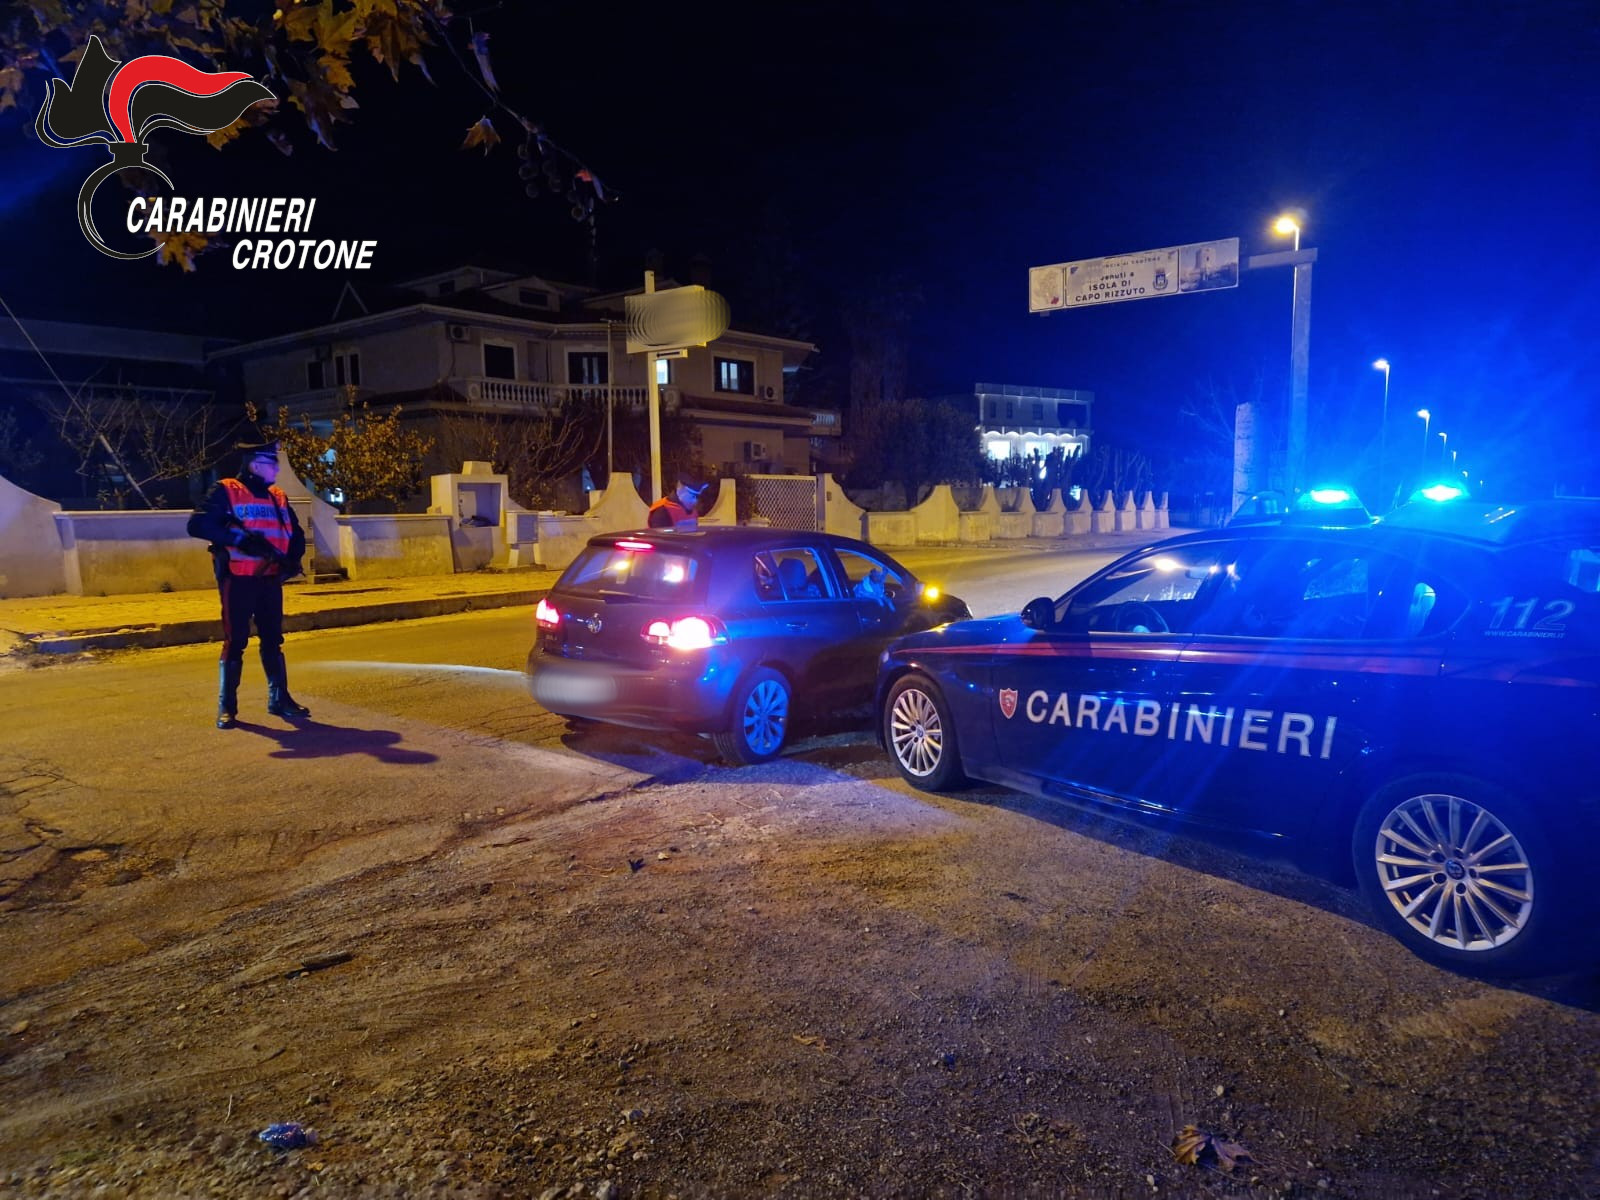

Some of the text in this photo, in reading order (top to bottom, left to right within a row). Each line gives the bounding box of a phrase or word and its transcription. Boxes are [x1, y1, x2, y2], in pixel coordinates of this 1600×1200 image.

[1075, 287, 1146, 302] CAPO RIZZUTO
[1089, 279, 1131, 291] ISOLA DI
[1489, 596, 1575, 631] 112
[1026, 690, 1338, 760] CARABINIERI
